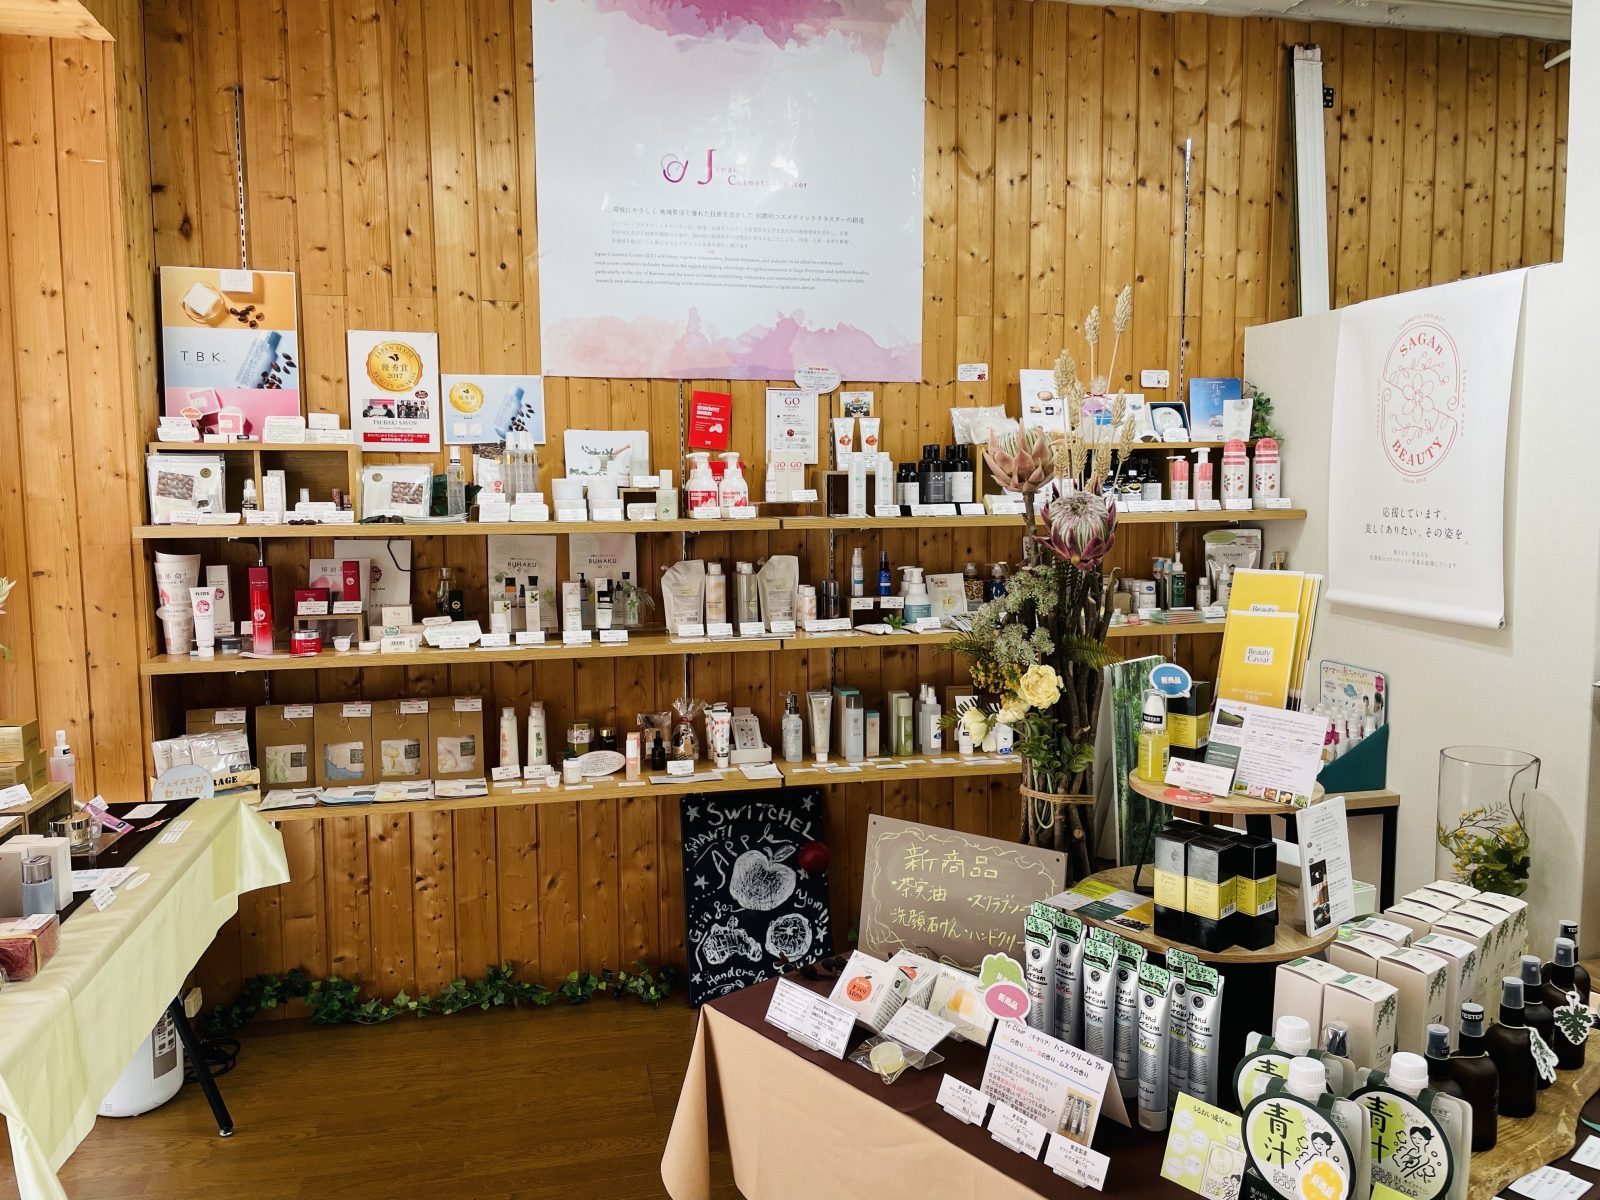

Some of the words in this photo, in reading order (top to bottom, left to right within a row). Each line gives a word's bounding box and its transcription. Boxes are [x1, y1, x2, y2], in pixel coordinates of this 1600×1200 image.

[728, 174, 773, 188] Cosmeti
[381, 363, 408, 372] 優秀賞
[784, 396, 800, 406] GO
[1391, 437, 1443, 466] BEAUTY
[1383, 506, 1446, 520] 応援しています。
[507, 561, 537, 569] RUHAKU
[1247, 655, 1270, 663] Caviar
[1248, 647, 1271, 657] Beauty
[158, 775, 208, 787] フェイスマスク
[214, 776, 238, 786] RAGE
[706, 801, 816, 841] SWITCHEL
[903, 842, 998, 879] 新商品
[1086, 984, 1103, 997] Hand
[1084, 992, 1106, 1005] Cream
[1140, 1009, 1157, 1023] Hand
[1188, 1010, 1208, 1024] Hand
[1002, 1034, 1089, 1079] の香り・ローズの香り・ムスクの香り
[1053, 1043, 1093, 1066] ハンドクリーム
[1263, 1102, 1294, 1169] 青汁
[1273, 1175, 1297, 1191] BODY
[1395, 1182, 1418, 1197] SOAP
